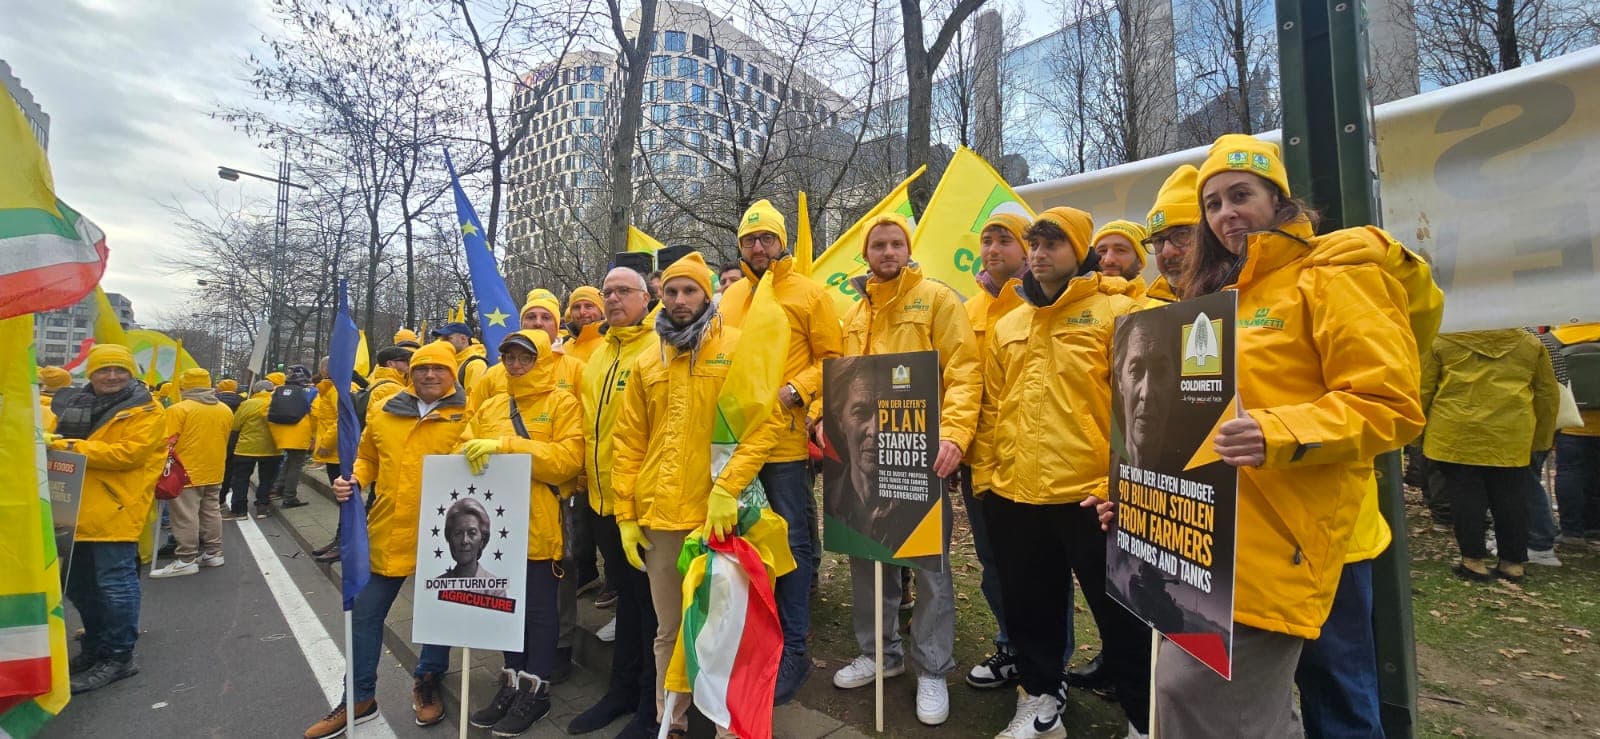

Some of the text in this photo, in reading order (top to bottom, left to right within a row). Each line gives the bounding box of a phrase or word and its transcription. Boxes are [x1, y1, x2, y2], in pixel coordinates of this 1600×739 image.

[1181, 380, 1222, 391] COLDIRETTI
[878, 400, 927, 409] VON DER LEYEN'S
[879, 409, 926, 432] PLAN
[878, 432, 928, 451] STARVES
[54, 462, 75, 473] FOODS
[878, 449, 928, 468] EUROPE
[1120, 464, 1215, 503] THE VON DER LEYEN BUDGET:
[879, 489, 928, 502] FOOD SOVEREIGNTY
[1119, 480, 1214, 532] 90 BILLION STOLEN
[1118, 502, 1213, 567] FROM FARMERS
[1117, 530, 1212, 593] FOR BOMBS AND TANKS
[426, 578, 508, 589] DON'T TURN OFF
[441, 591, 513, 611] AGRICULTURE
